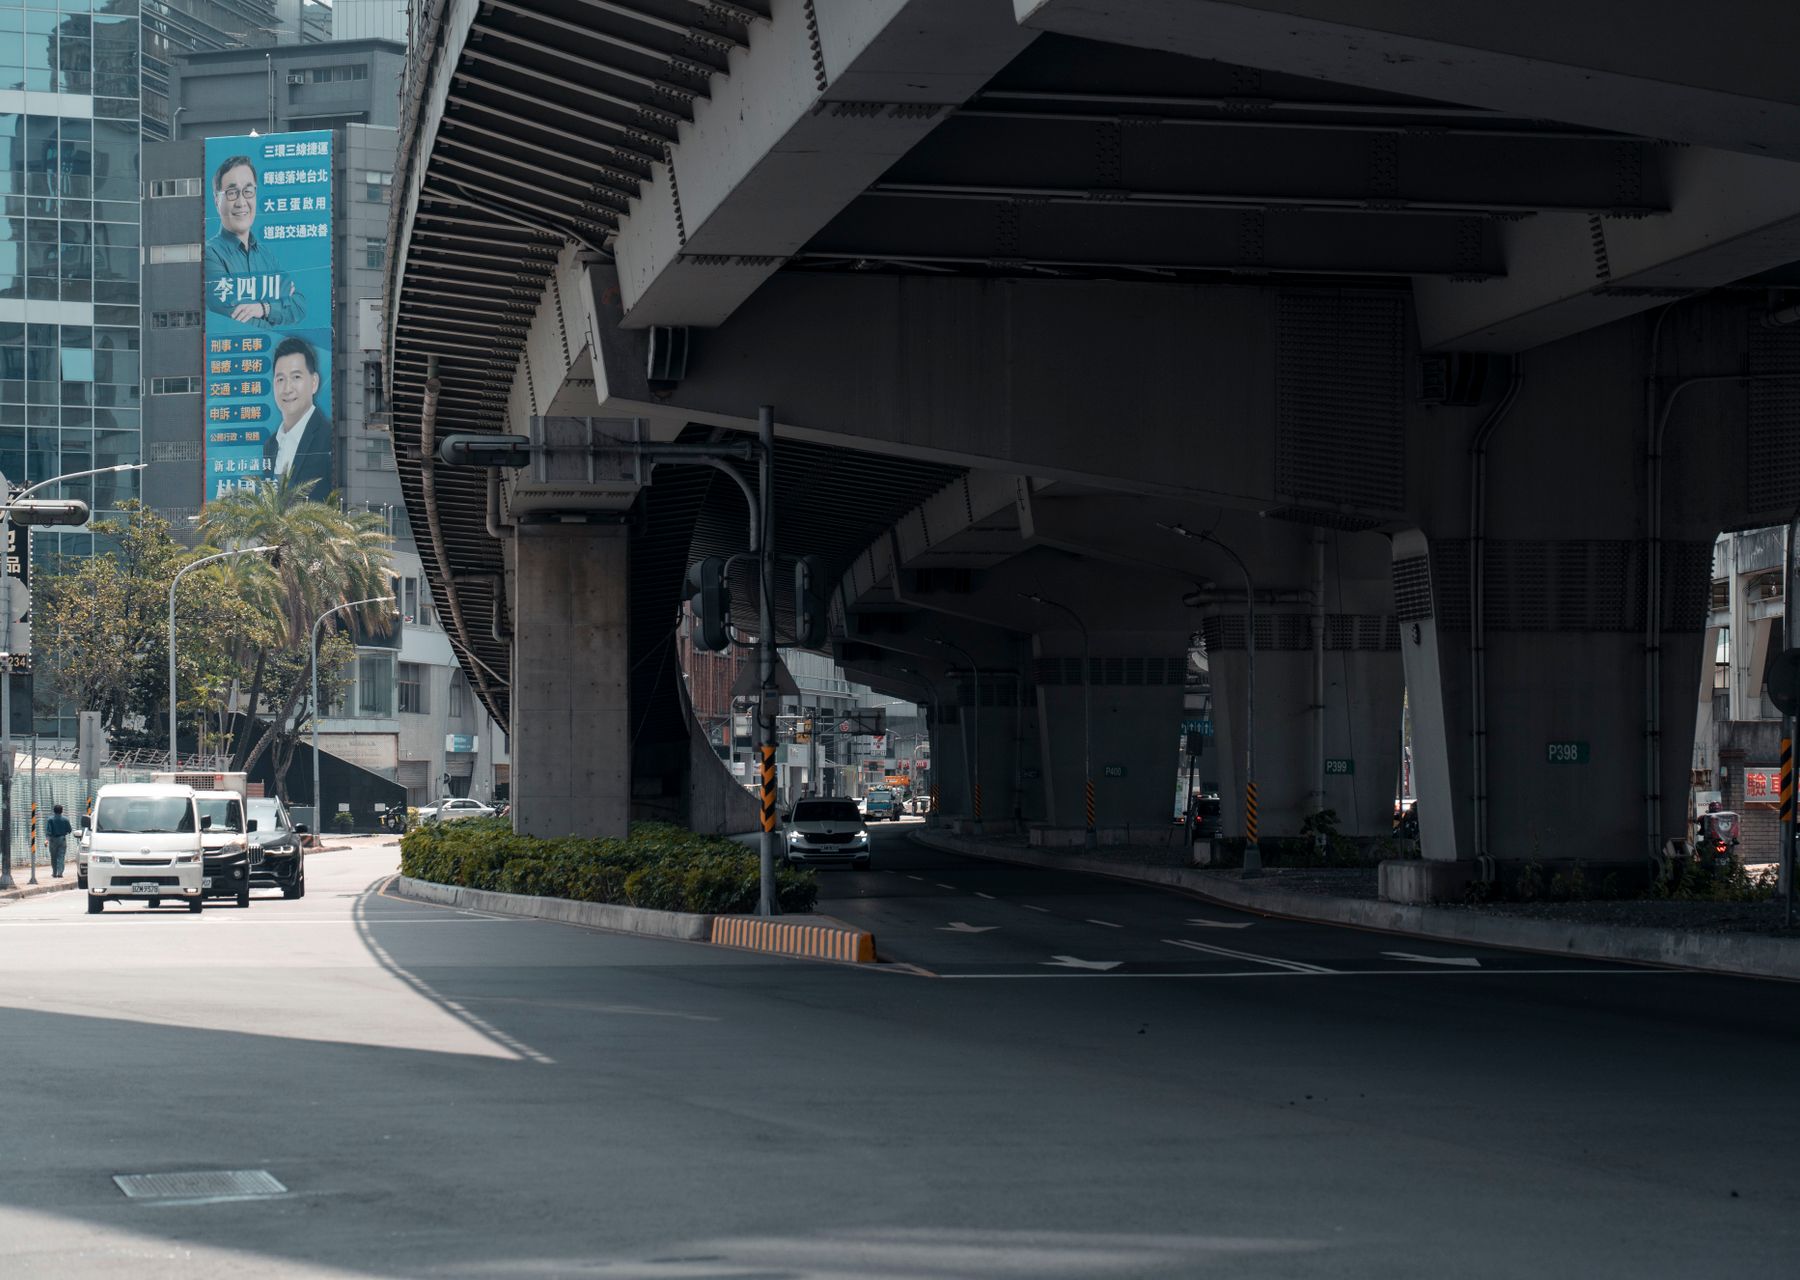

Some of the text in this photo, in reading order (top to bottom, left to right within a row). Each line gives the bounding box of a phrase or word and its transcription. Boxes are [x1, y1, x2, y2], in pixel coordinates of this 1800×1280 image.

[264, 142, 329, 158] 三環三線捷運
[263, 169, 328, 185] 輝達落地台北
[264, 224, 328, 240] 道路交通改善
[213, 274, 281, 303] 李四川
[214, 458, 272, 473] 新北市議員
[1549, 744, 1578, 761] P398
[1105, 766, 1122, 777] P400
[1326, 760, 1347, 773] P399
